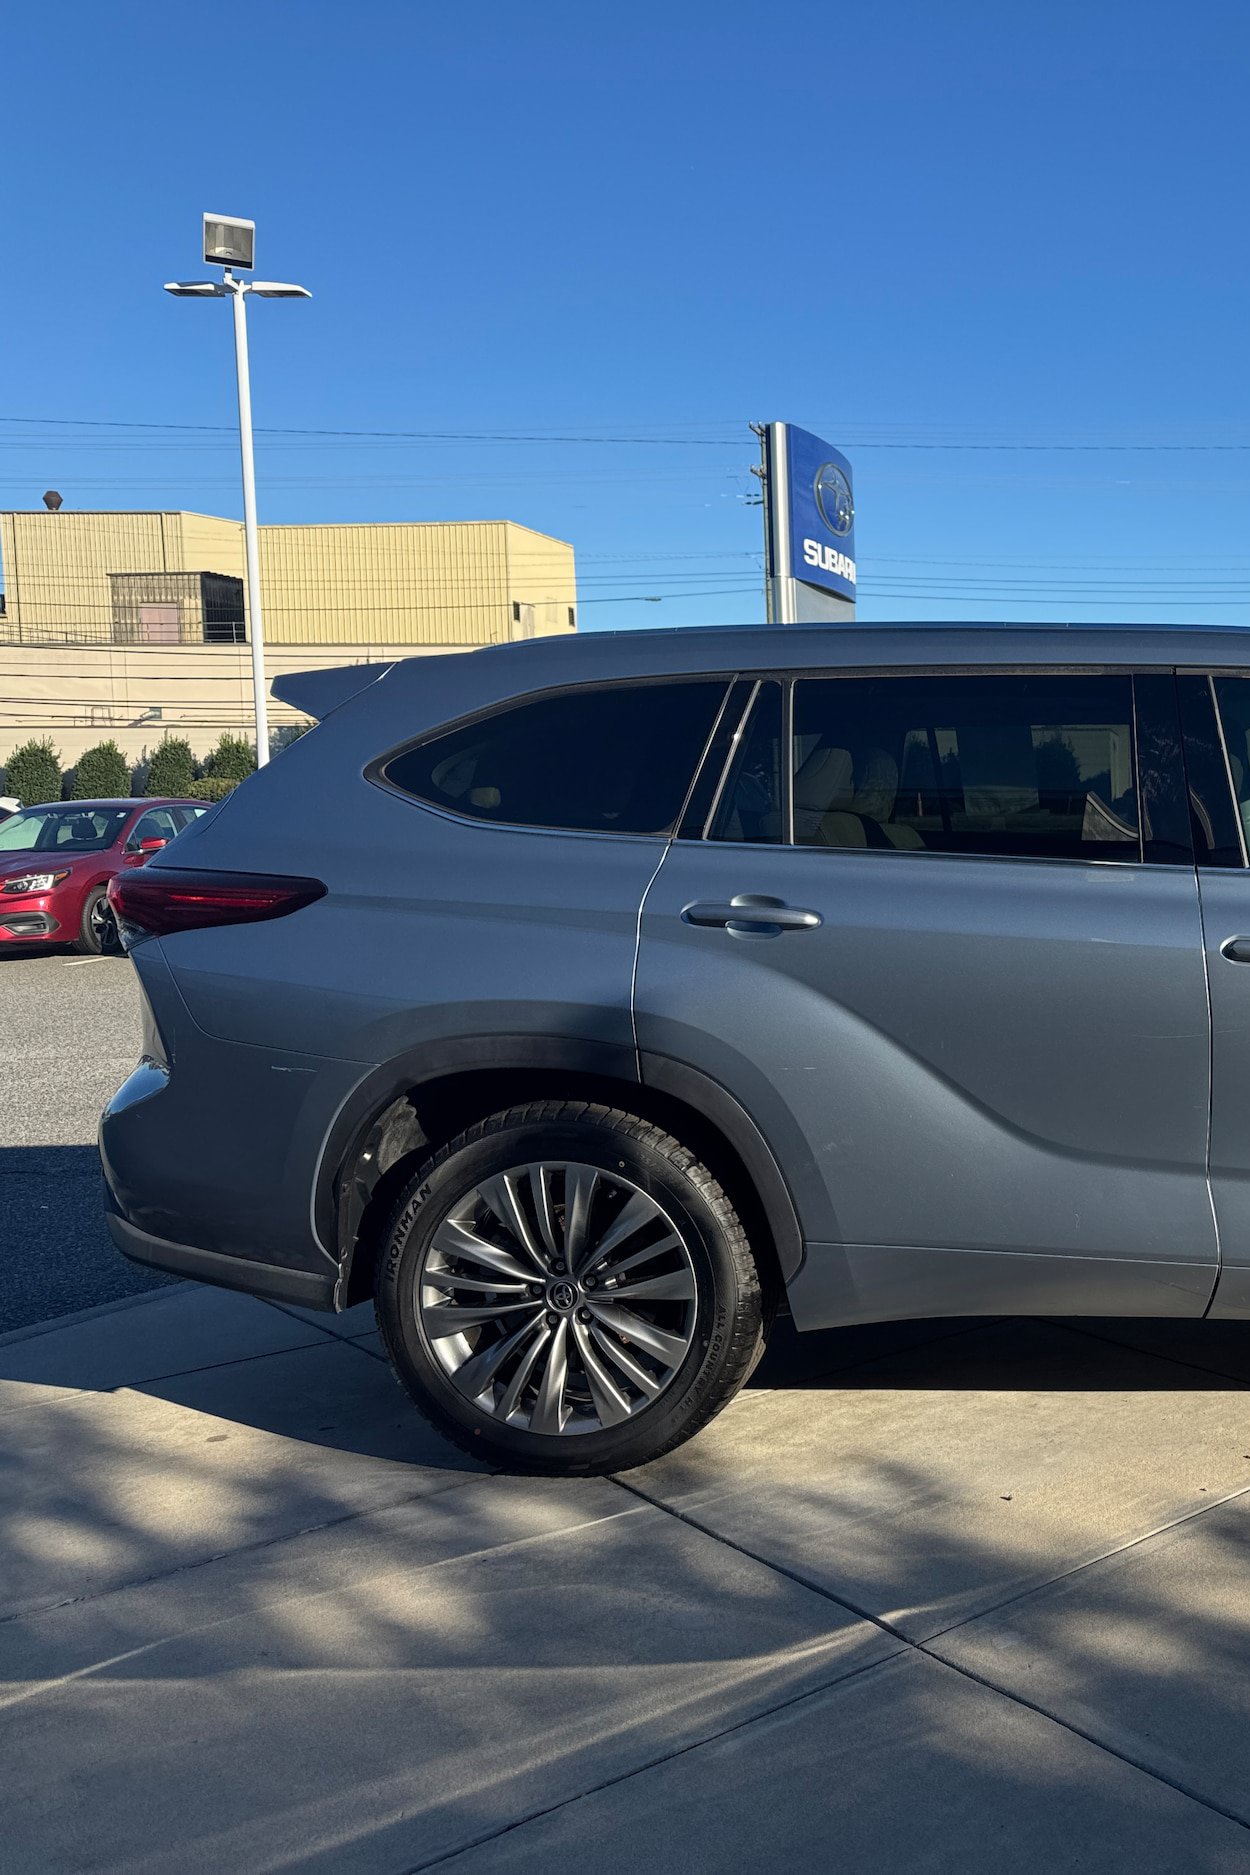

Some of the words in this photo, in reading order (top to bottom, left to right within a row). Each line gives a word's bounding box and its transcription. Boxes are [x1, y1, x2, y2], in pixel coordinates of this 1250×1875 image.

[385, 1183, 432, 1283] IRONMAN
[715, 1304, 727, 1330] ALL
[690, 1333, 723, 1396] COUNTRY
